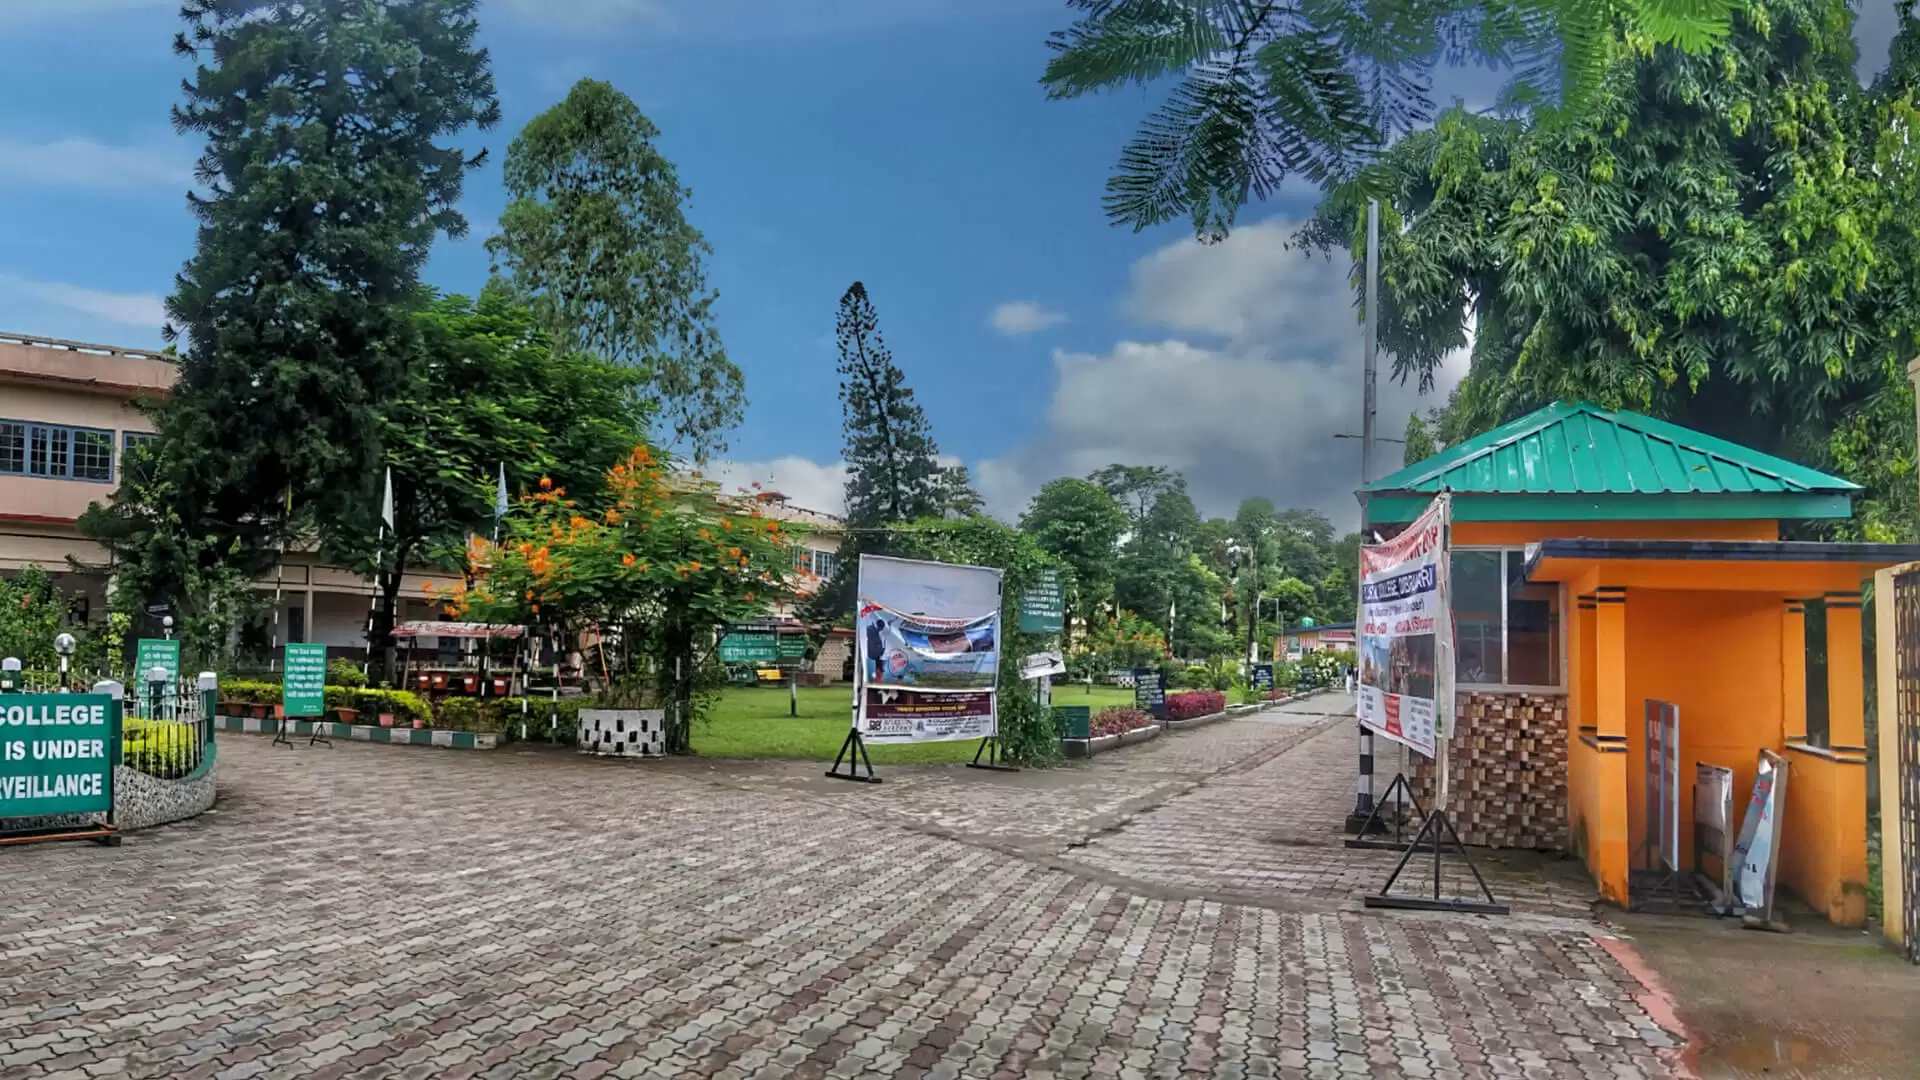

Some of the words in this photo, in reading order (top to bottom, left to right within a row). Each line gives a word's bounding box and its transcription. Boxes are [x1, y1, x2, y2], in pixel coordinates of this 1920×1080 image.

[5, 740, 26, 760] IS
[32, 740, 104, 760] UNDER
[0, 773, 101, 799] VEILLANCE
